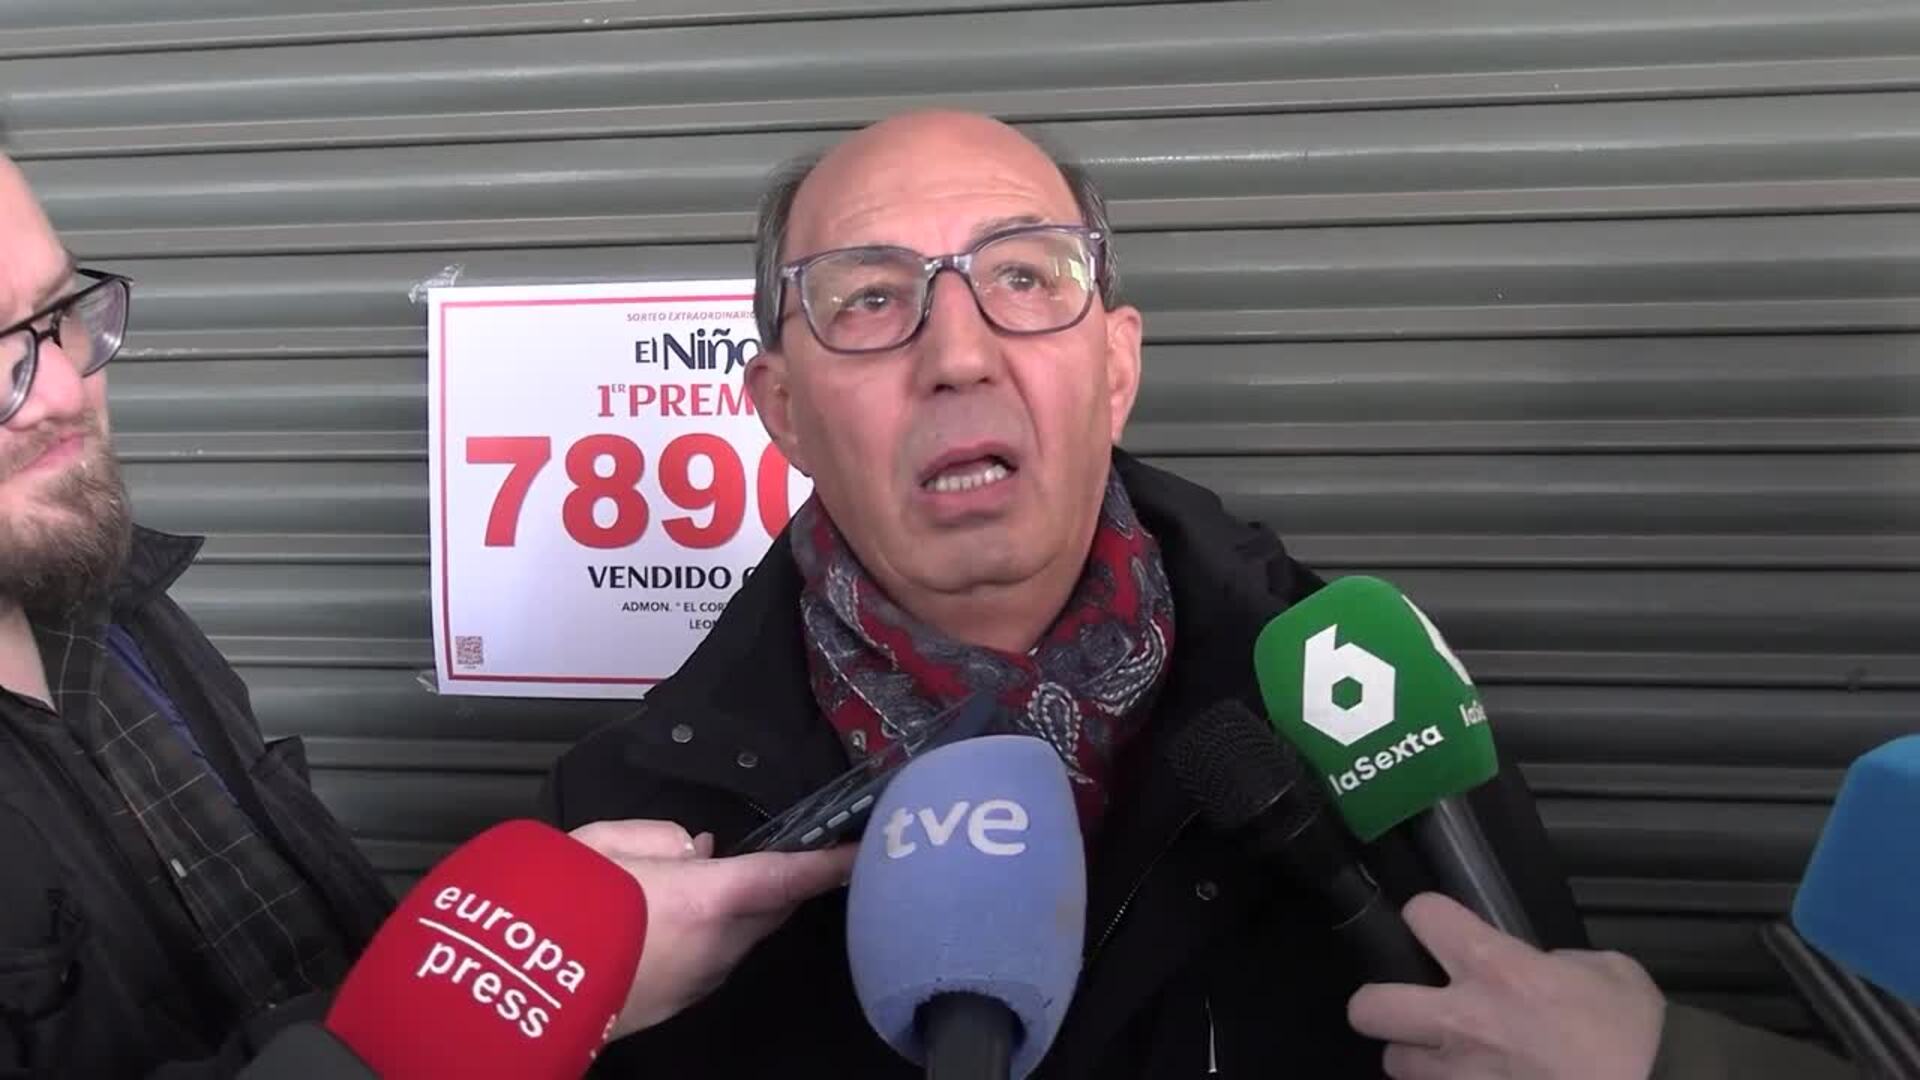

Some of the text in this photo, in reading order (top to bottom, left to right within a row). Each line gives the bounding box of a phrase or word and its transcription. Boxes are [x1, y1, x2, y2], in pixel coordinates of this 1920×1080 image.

[627, 312, 666, 321] SORTEO
[635, 337, 657, 363] El
[588, 565, 732, 589] VENDIDO
[622, 602, 672, 612] ADMON.
[1329, 725, 1445, 796] laSexta
[884, 799, 1030, 859] tve
[434, 886, 585, 993] europa
[416, 942, 549, 1038] press
